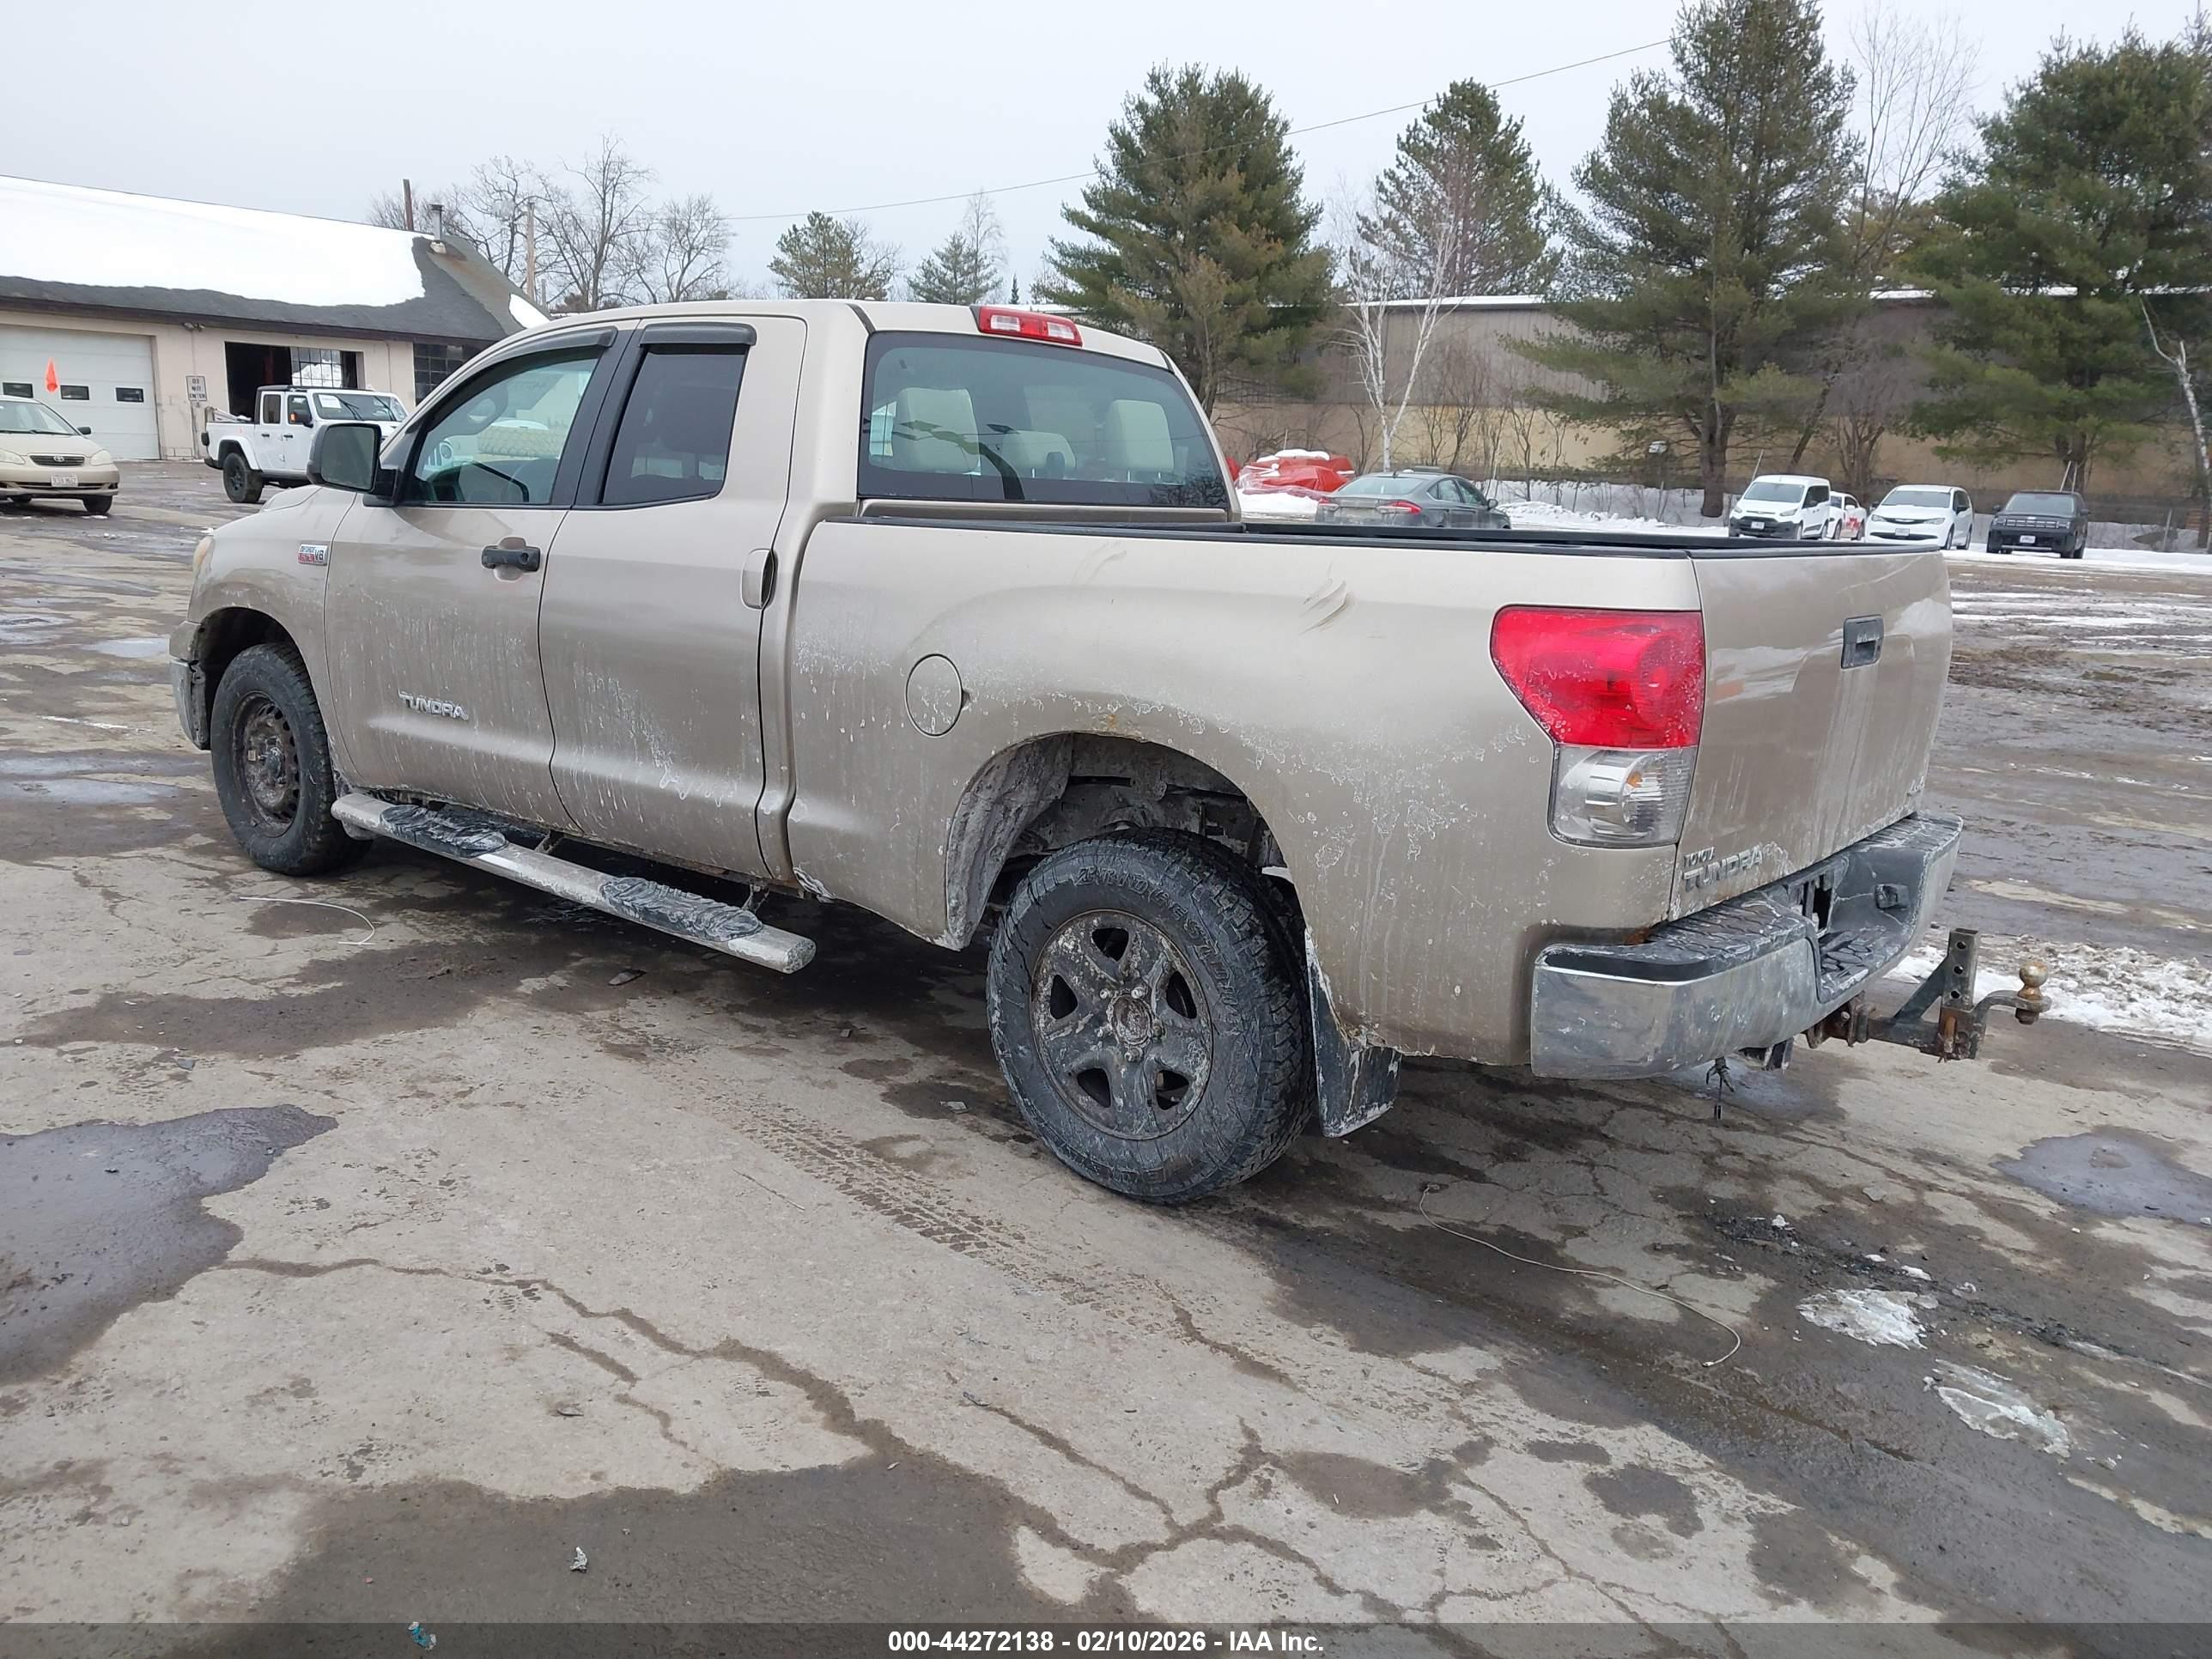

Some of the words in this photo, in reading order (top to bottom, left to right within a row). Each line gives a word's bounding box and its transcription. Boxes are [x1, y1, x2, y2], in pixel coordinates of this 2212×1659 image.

[314, 549, 325, 561] V8
[398, 688, 469, 721] TUNDRA
[1683, 844, 1763, 893] TUNDRA
